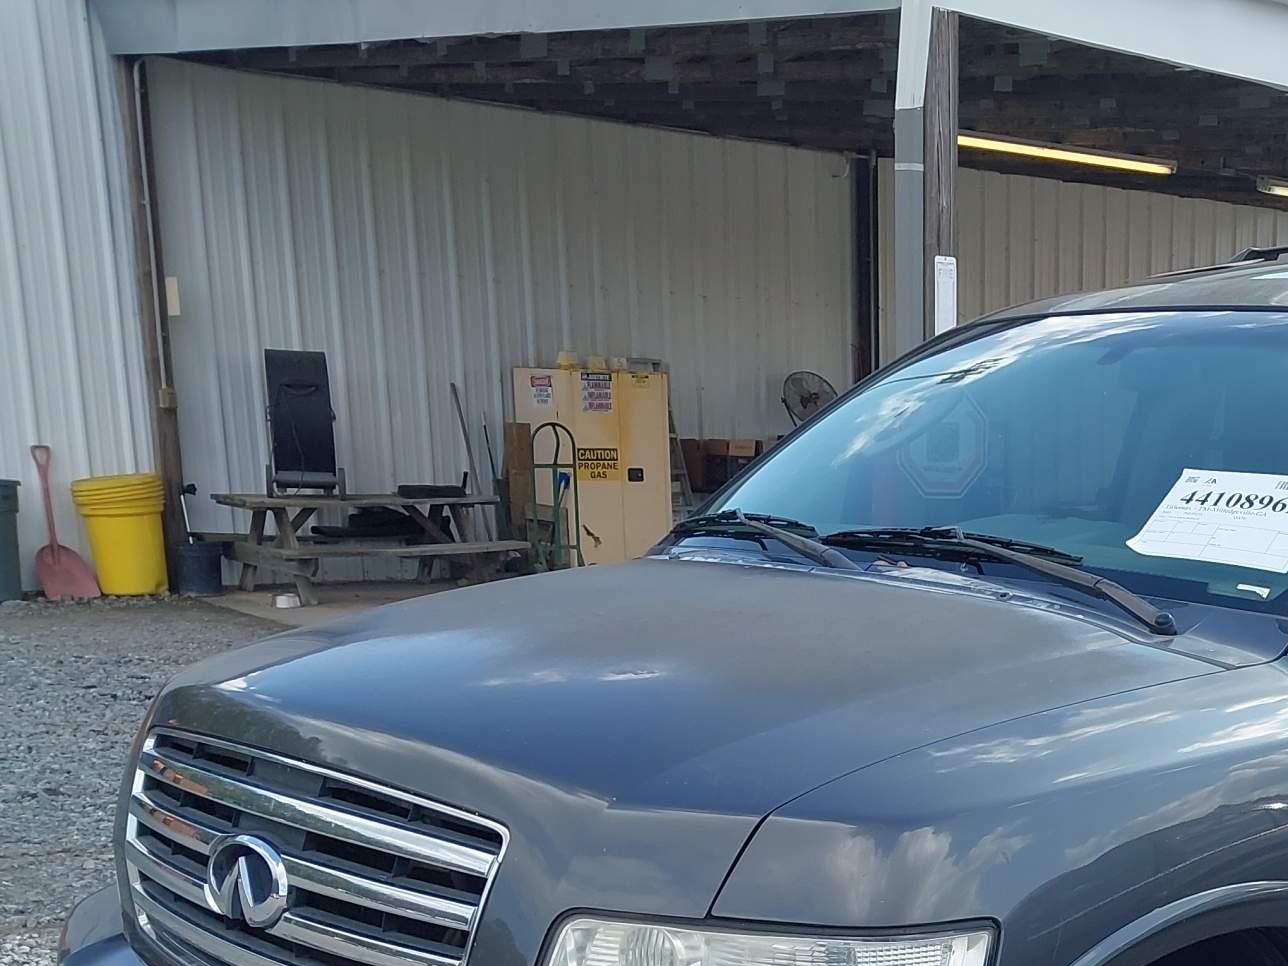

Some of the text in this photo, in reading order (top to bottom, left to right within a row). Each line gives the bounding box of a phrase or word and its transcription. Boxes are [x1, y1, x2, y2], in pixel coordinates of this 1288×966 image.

[578, 449, 617, 460] CAUTION
[578, 462, 619, 470] PROPANE
[590, 471, 607, 479] GAS
